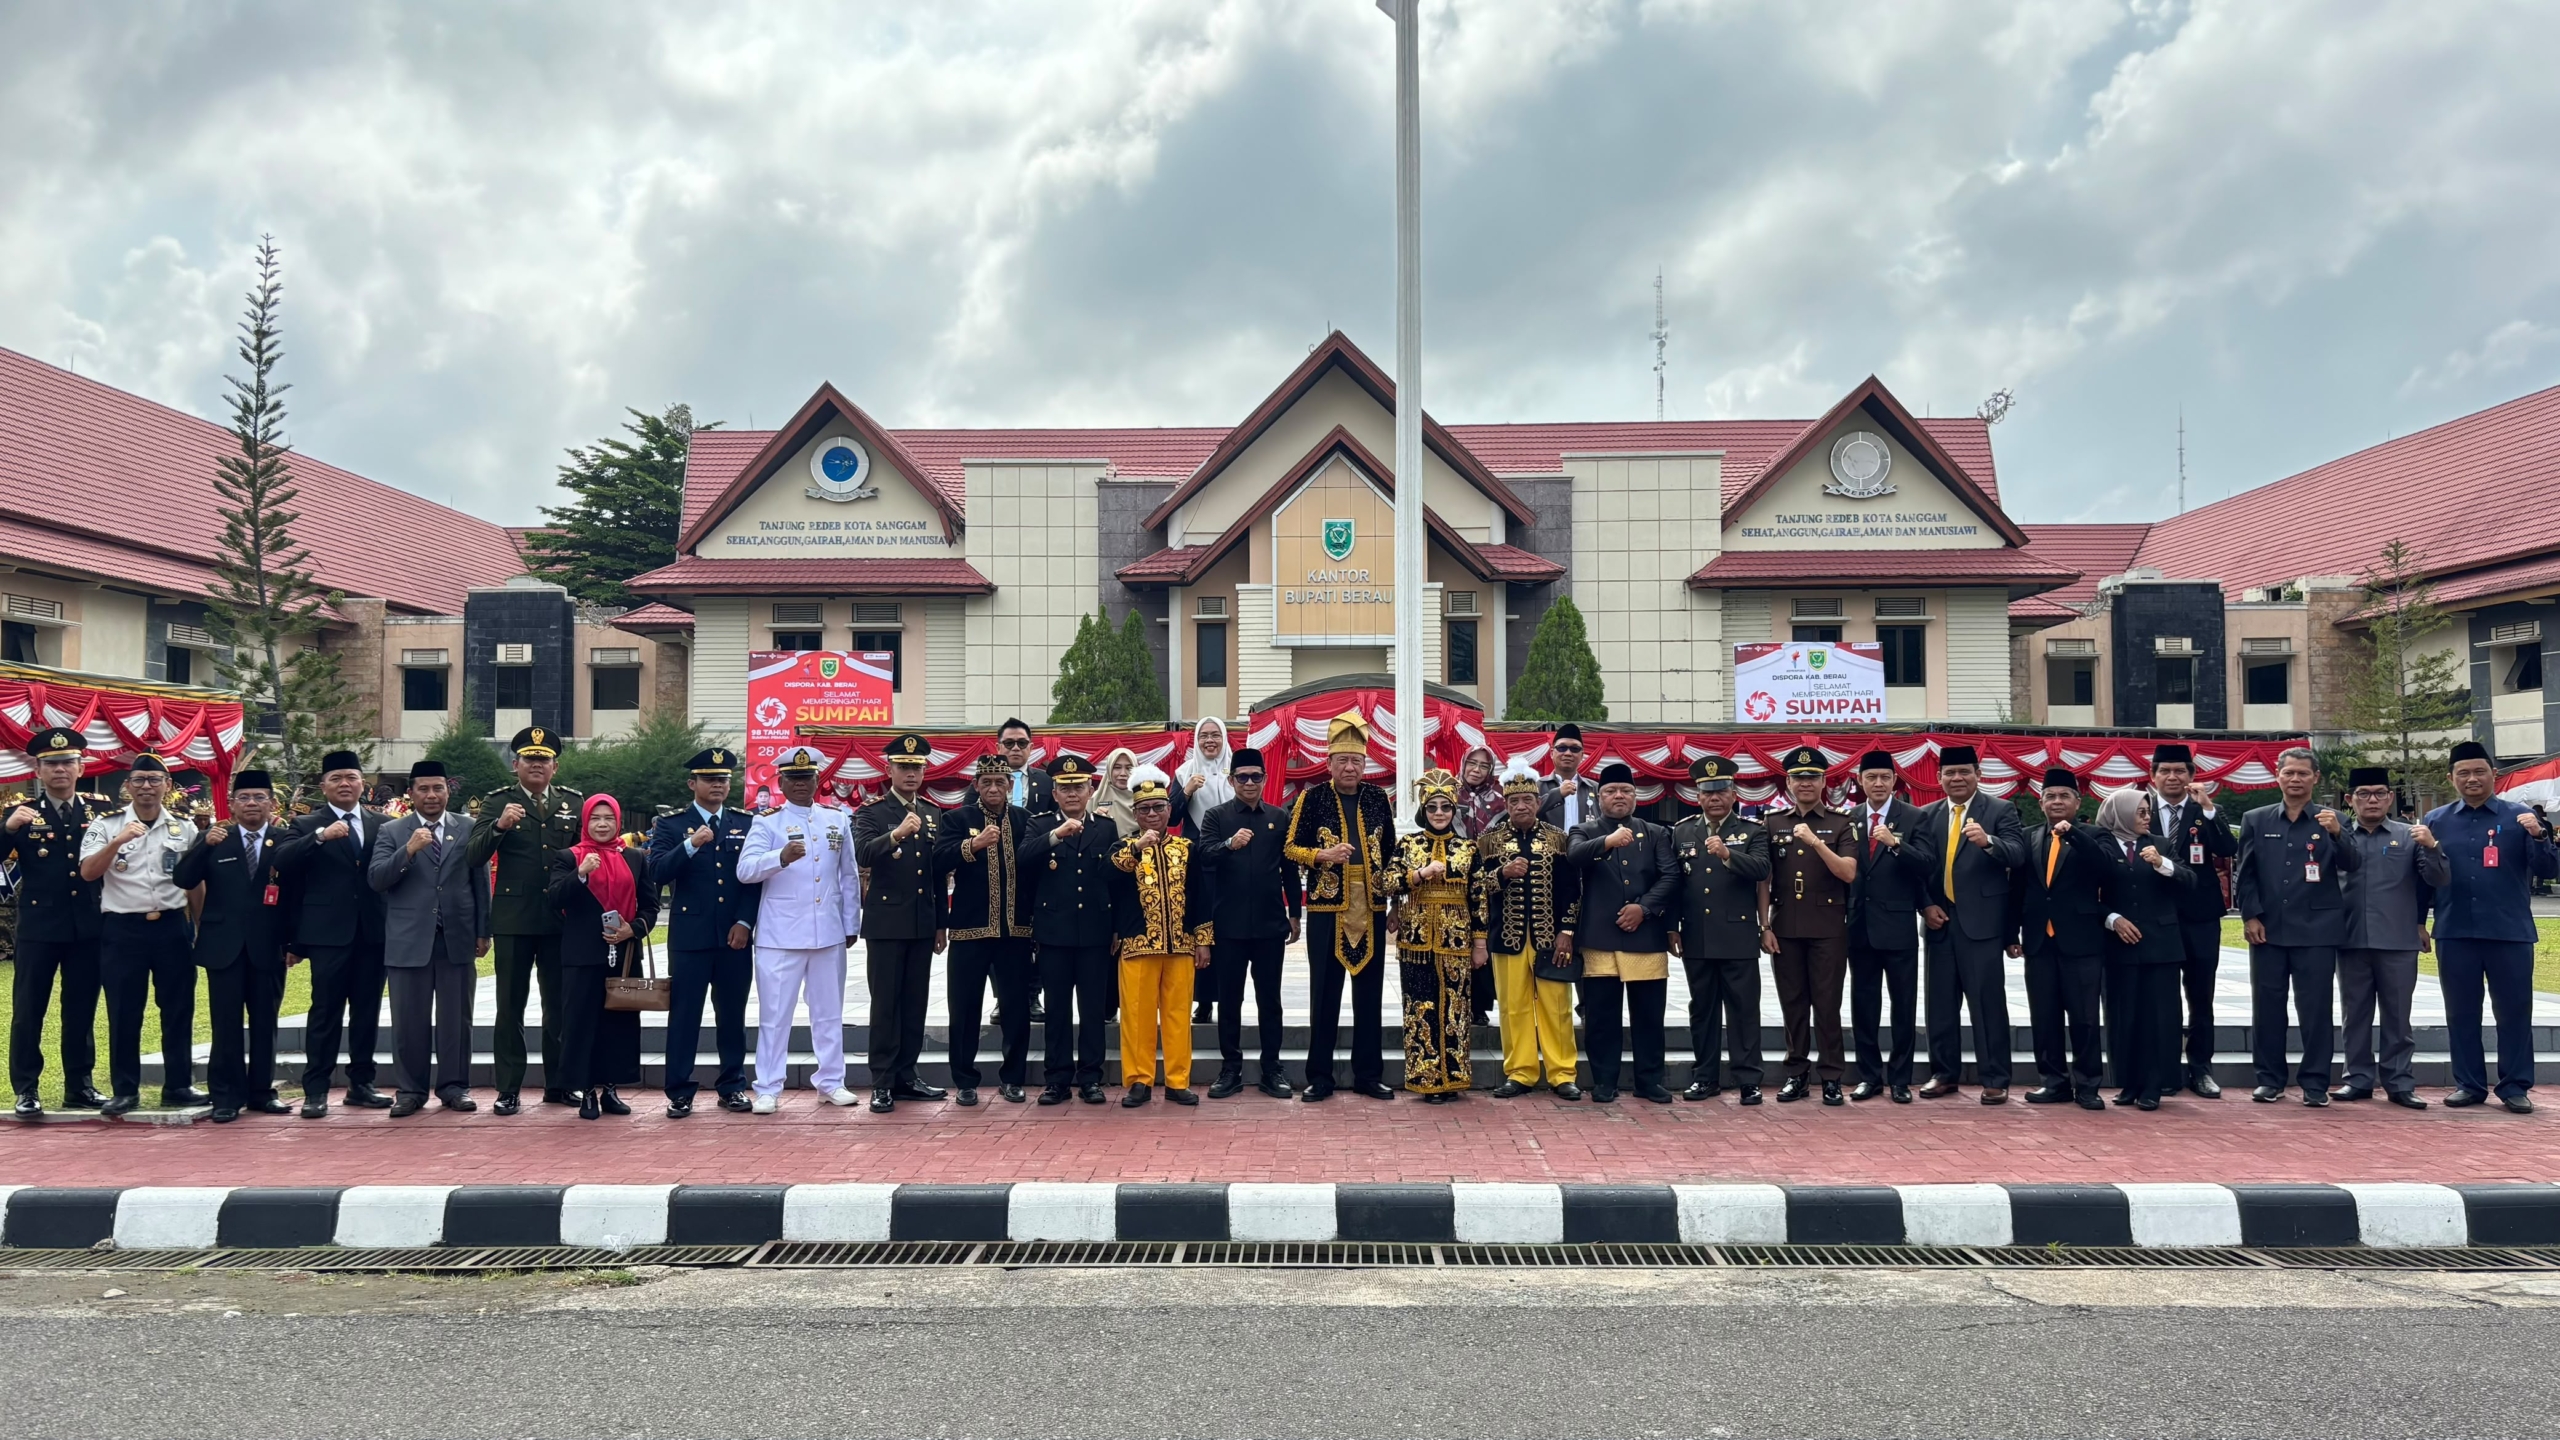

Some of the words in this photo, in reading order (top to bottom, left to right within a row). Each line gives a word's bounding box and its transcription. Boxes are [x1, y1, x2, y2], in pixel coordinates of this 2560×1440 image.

[1844, 486, 1880, 497] BERAU
[1775, 513, 1823, 524] TANJUNG
[1825, 513, 1859, 523] REDEB
[1862, 513, 1892, 523] KOTA
[1895, 513, 1947, 523] SANGGAM
[759, 521, 805, 531] TANJUNG
[808, 521, 841, 530] REDEB
[844, 521, 872, 530] KOTA
[875, 521, 927, 530] SANGGAM
[1895, 526, 1917, 536] DAN
[1918, 525, 1978, 536] MANUSIAWI
[876, 535, 897, 545] DAN
[1307, 569, 1370, 583] KANTOR
[1285, 590, 1337, 604] BUPATI
[1341, 590, 1393, 603] BERAU
[1785, 698, 1881, 715] SUMPAH
[795, 706, 888, 722] SUMPAH
[758, 746, 774, 757] 28
